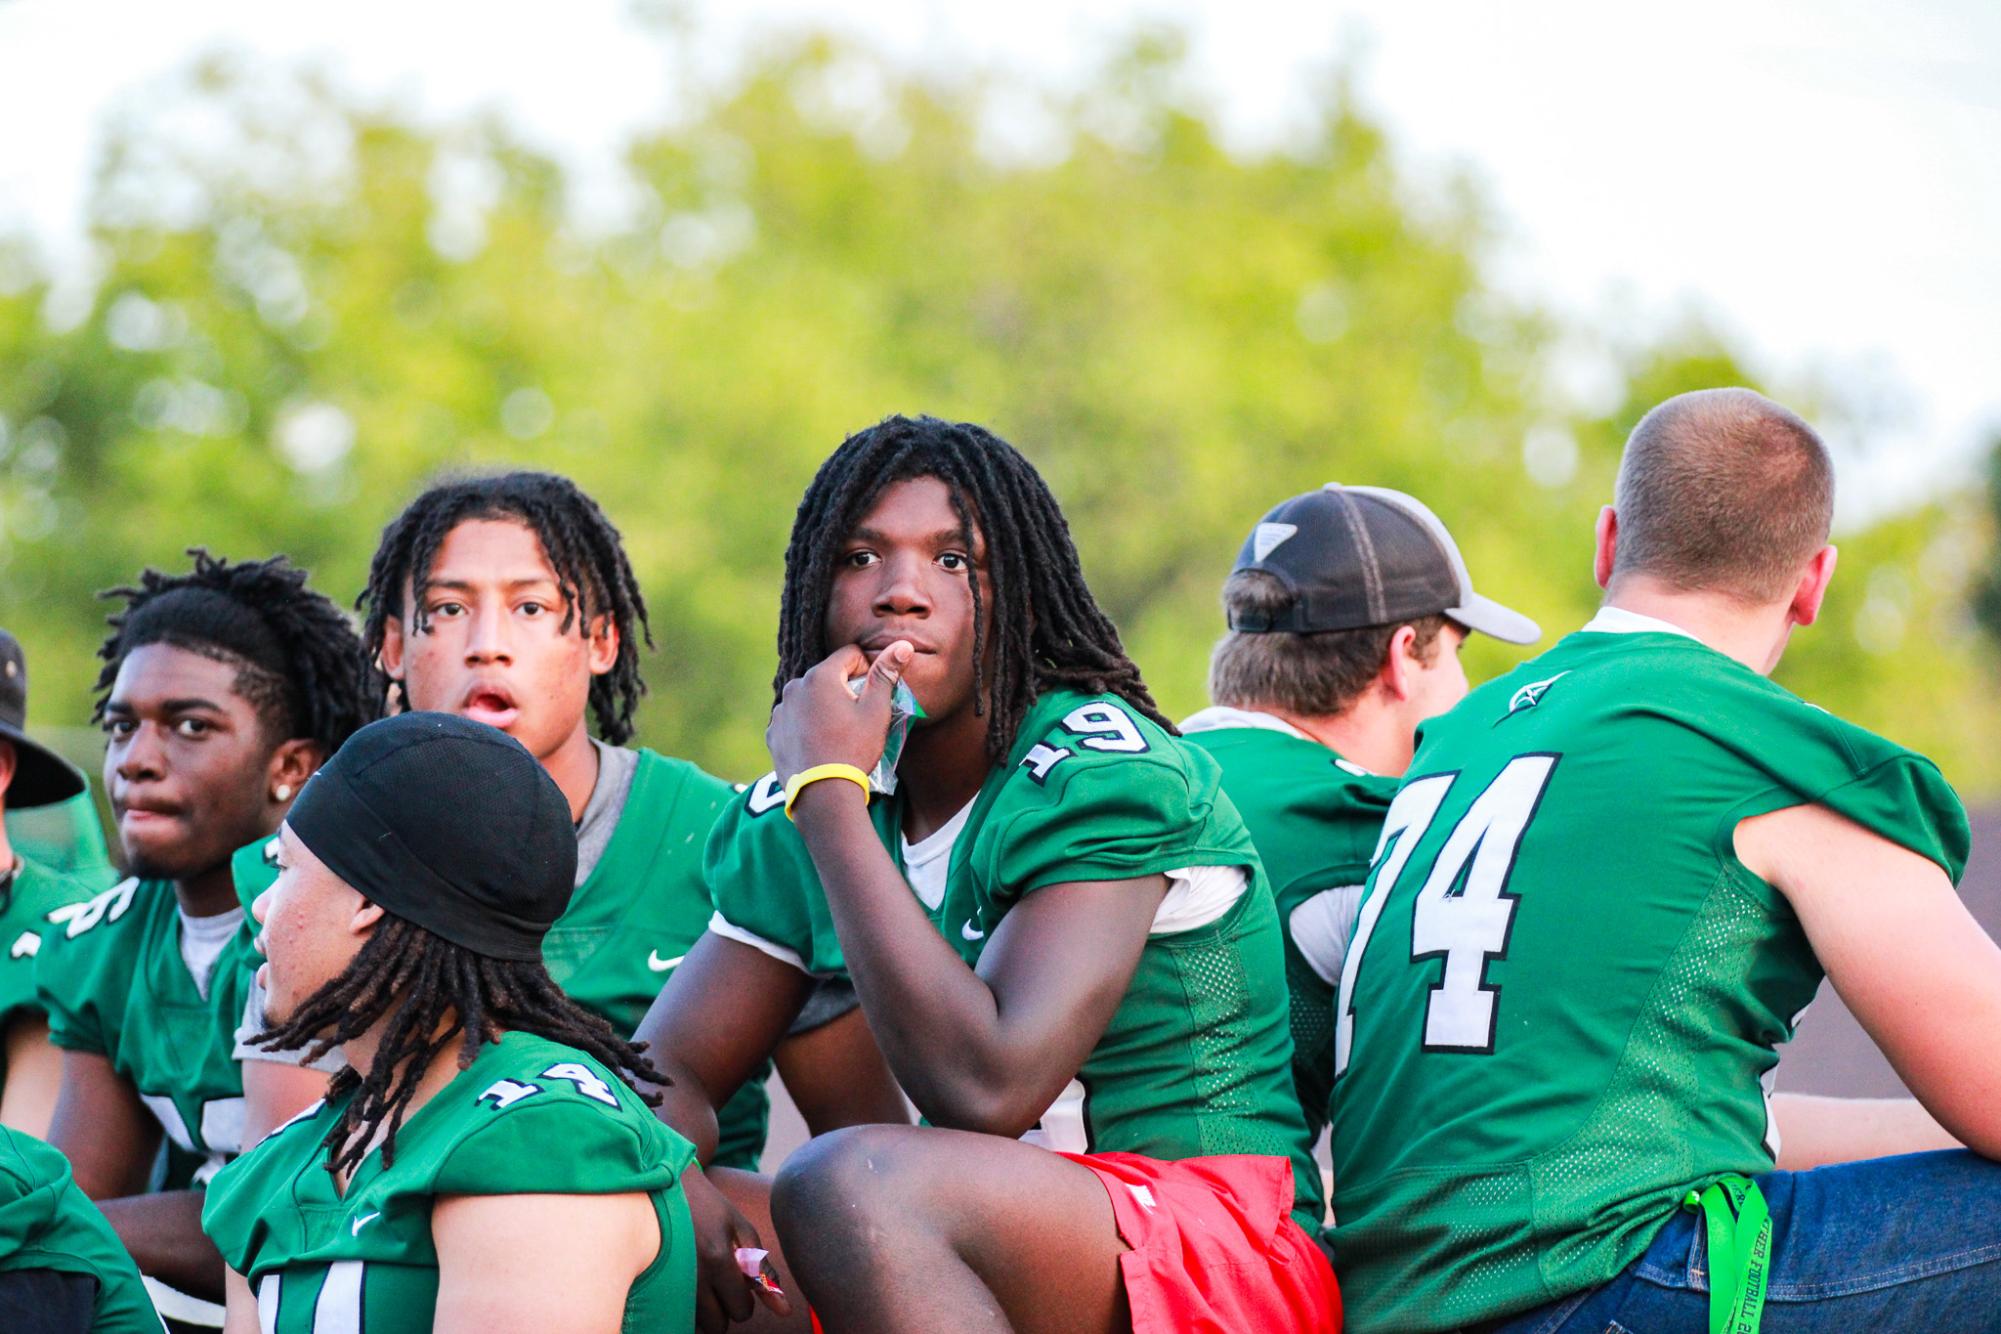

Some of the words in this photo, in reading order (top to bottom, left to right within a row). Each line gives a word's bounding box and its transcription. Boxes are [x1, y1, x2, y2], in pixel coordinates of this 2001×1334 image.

[1019, 701, 1151, 786] 19
[1334, 752, 1563, 1070] 74
[475, 1063, 622, 1112] 14
[1741, 1259, 1763, 1318] FOOTBALL
